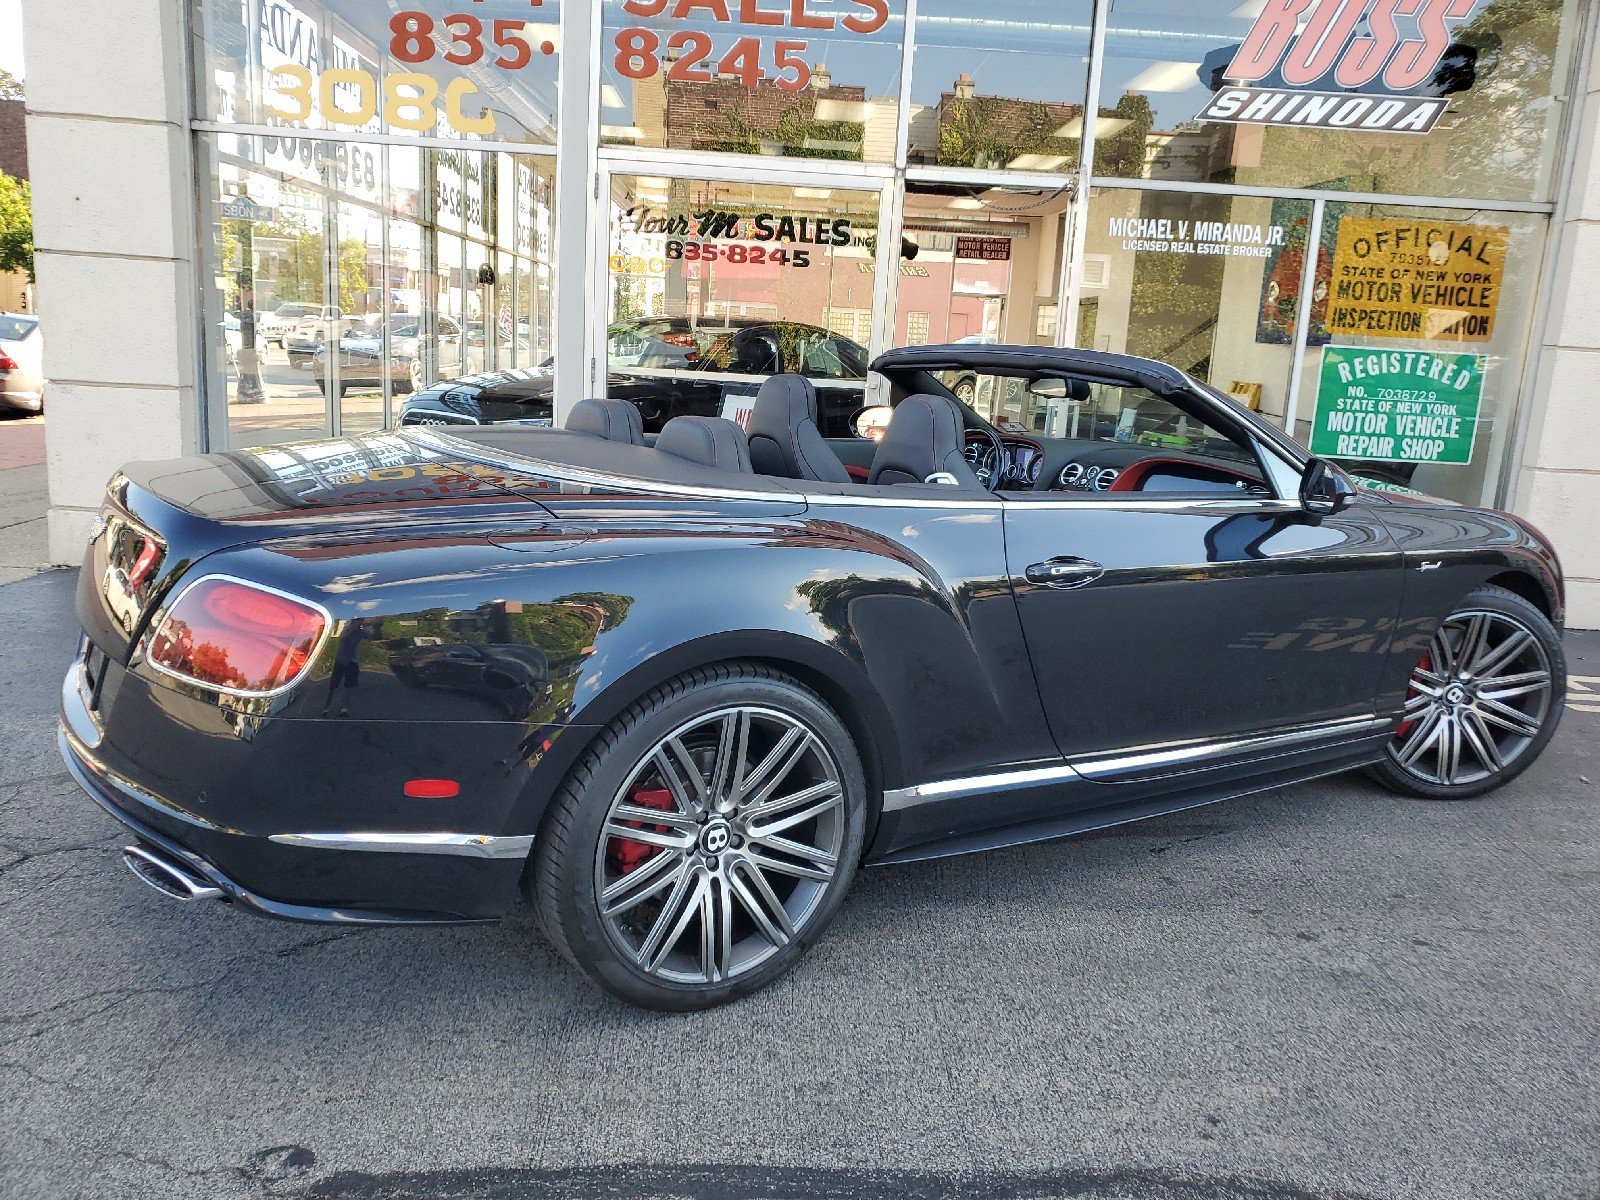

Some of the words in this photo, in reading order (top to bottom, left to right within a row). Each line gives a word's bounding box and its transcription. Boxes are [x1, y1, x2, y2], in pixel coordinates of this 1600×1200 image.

[1222, 0, 1476, 90] BOSS
[614, 28, 811, 92] 8245
[1207, 90, 1439, 130] SHINODA
[754, 213, 851, 247] SALES
[1108, 217, 1174, 239] MICHAEL
[1178, 220, 1189, 240] V.
[1194, 221, 1262, 244] MIRANDA
[1264, 225, 1286, 246] JR.
[958, 241, 980, 250] MOTOR
[983, 243, 1010, 252] VEHICLE
[959, 250, 982, 258] RETAIL
[983, 251, 1007, 259] DEALER
[1122, 239, 1169, 252] LICENSED
[1170, 241, 1195, 253] REAL
[1197, 243, 1231, 255] ESTATE
[1233, 245, 1273, 257] BROKER
[1353, 227, 1491, 266] OFFICIAL
[1342, 266, 1385, 279] STATE
[1391, 268, 1411, 279] OF
[1415, 270, 1448, 282] NEW
[1453, 272, 1492, 284] YORK
[1337, 280, 1402, 303] MOTOR
[1411, 283, 1493, 308] VEHICLE
[1331, 307, 1422, 332] INSPECTION
[1337, 352, 1471, 391] REGISTERED
[1337, 398, 1375, 411] STATE
[1378, 400, 1394, 412] OF
[1396, 402, 1426, 414] NEW
[1427, 403, 1457, 416] YORK
[1348, 385, 1367, 398] NO.
[1377, 388, 1437, 402] 7038729
[1327, 411, 1388, 434] MOTOR
[1396, 415, 1461, 438] VEHICLE
[1336, 435, 1394, 457] REPAIR
[1400, 438, 1445, 460] SHOP
